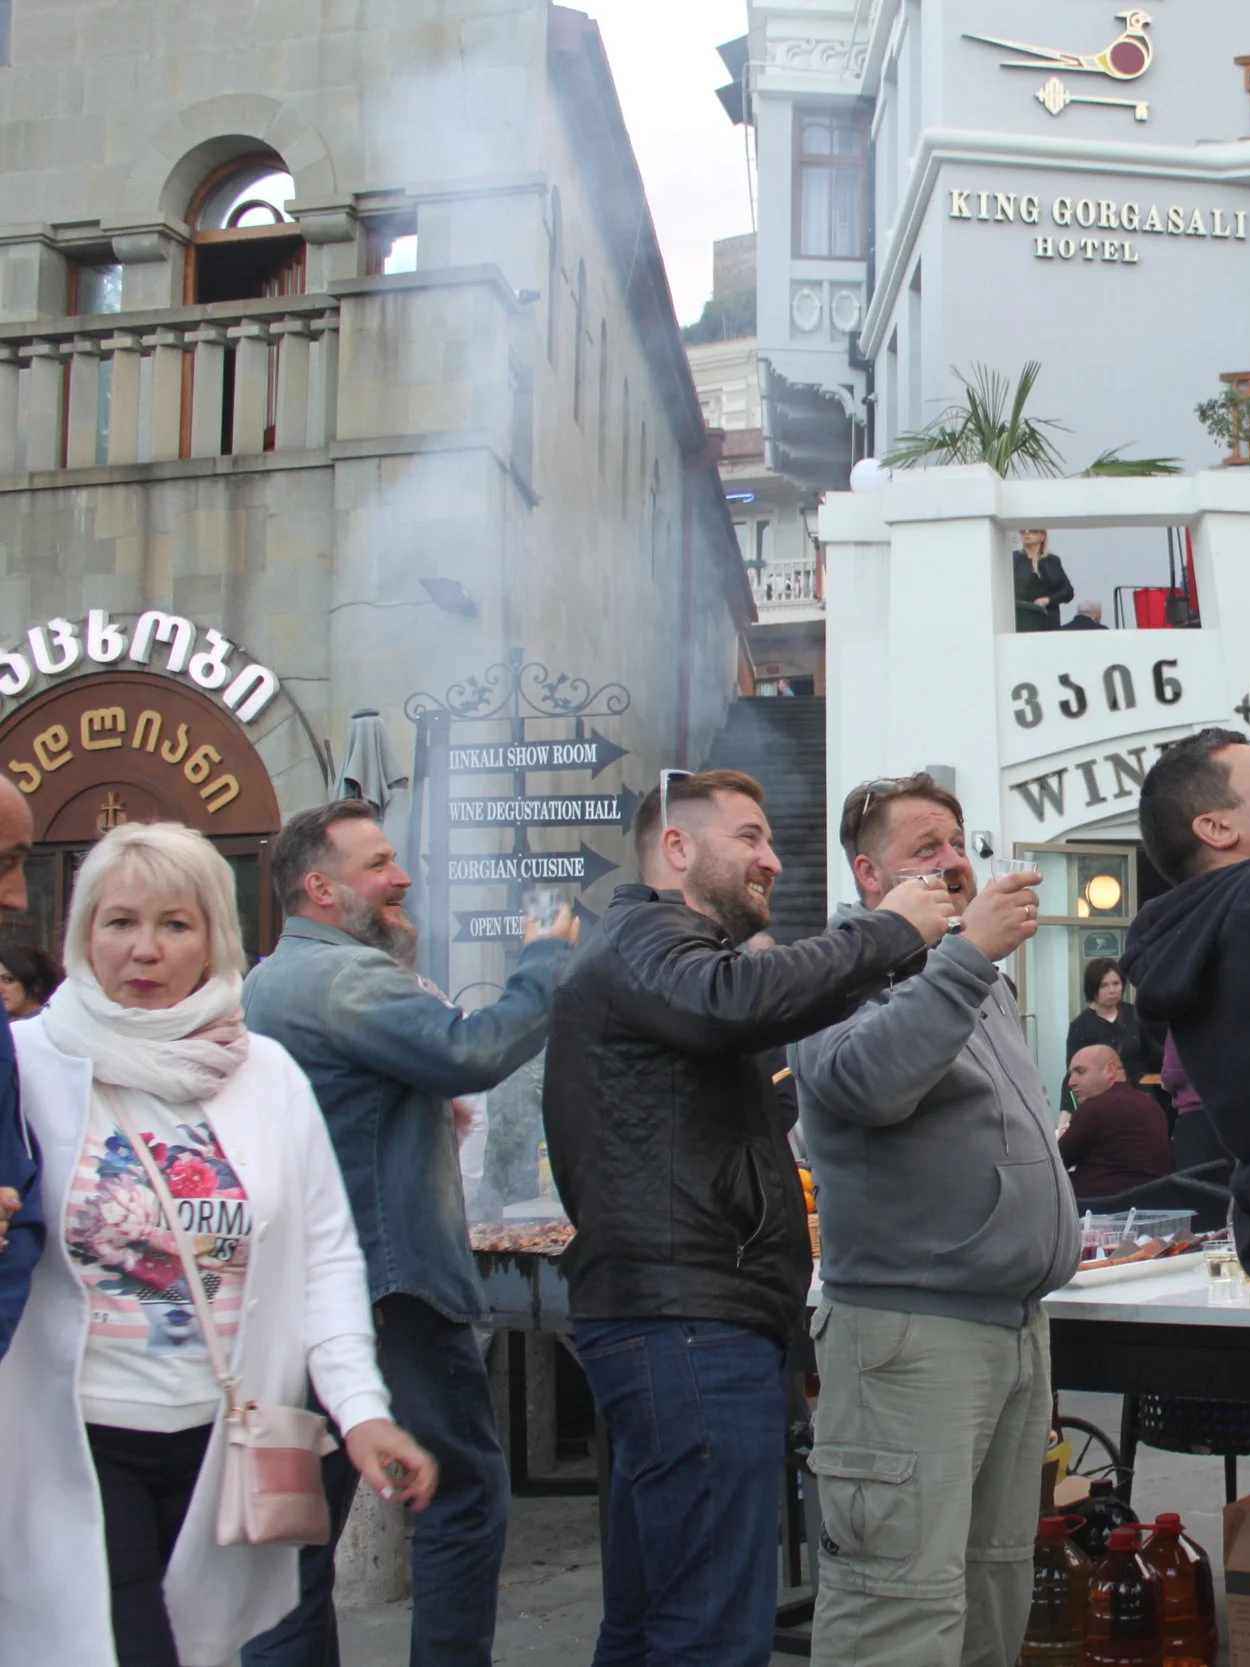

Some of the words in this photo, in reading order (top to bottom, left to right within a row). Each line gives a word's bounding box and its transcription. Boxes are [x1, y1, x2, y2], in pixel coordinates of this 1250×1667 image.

[949, 188, 1039, 224] KING
[1052, 197, 1248, 240] GORGASALI
[1034, 236, 1139, 263] HOTEL
[0, 609, 279, 724] აცხობი
[1011, 659, 1182, 729] ვაინ
[8, 706, 240, 814] ადლიანი
[507, 745, 549, 767] SHOW
[553, 743, 598, 765] ROOM
[449, 801, 484, 821] WINE
[487, 800, 582, 821] DEGUSTATION
[585, 799, 621, 820] HALL
[449, 859, 517, 880] EORGIAN
[520, 857, 585, 878] CUISINE
[470, 916, 502, 937] OPEN
